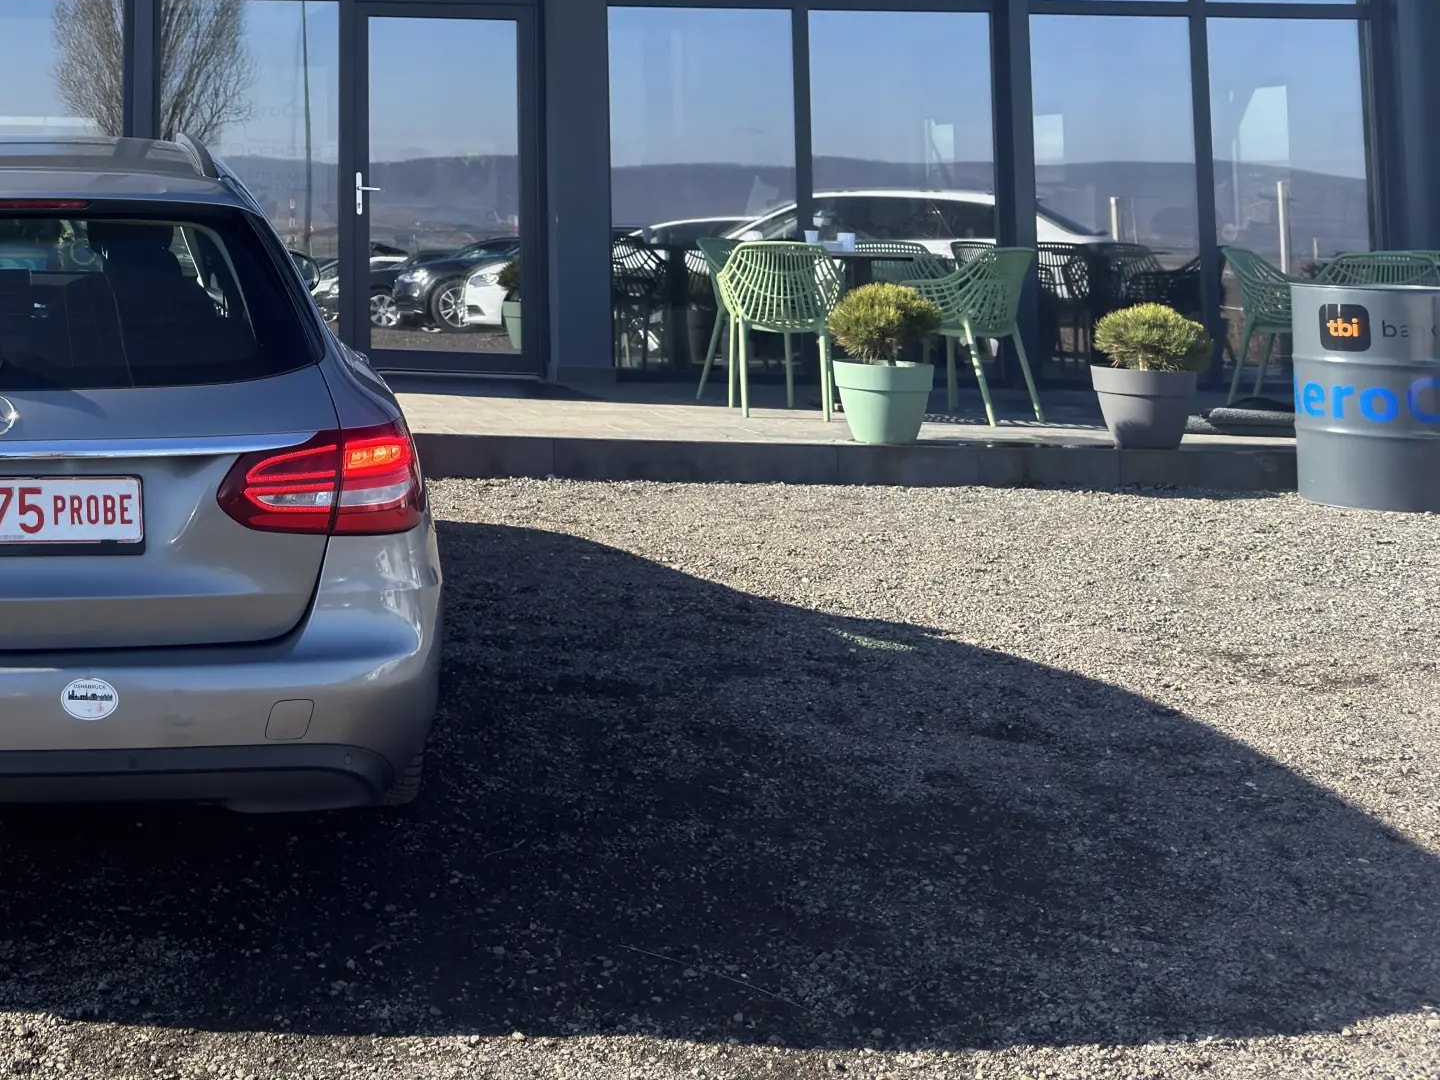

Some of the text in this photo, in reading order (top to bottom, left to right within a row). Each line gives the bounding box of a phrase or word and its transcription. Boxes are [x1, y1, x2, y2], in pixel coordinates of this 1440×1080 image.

[1326, 317, 1438, 338] tbi bak
[53, 494, 133, 525] PROBE
